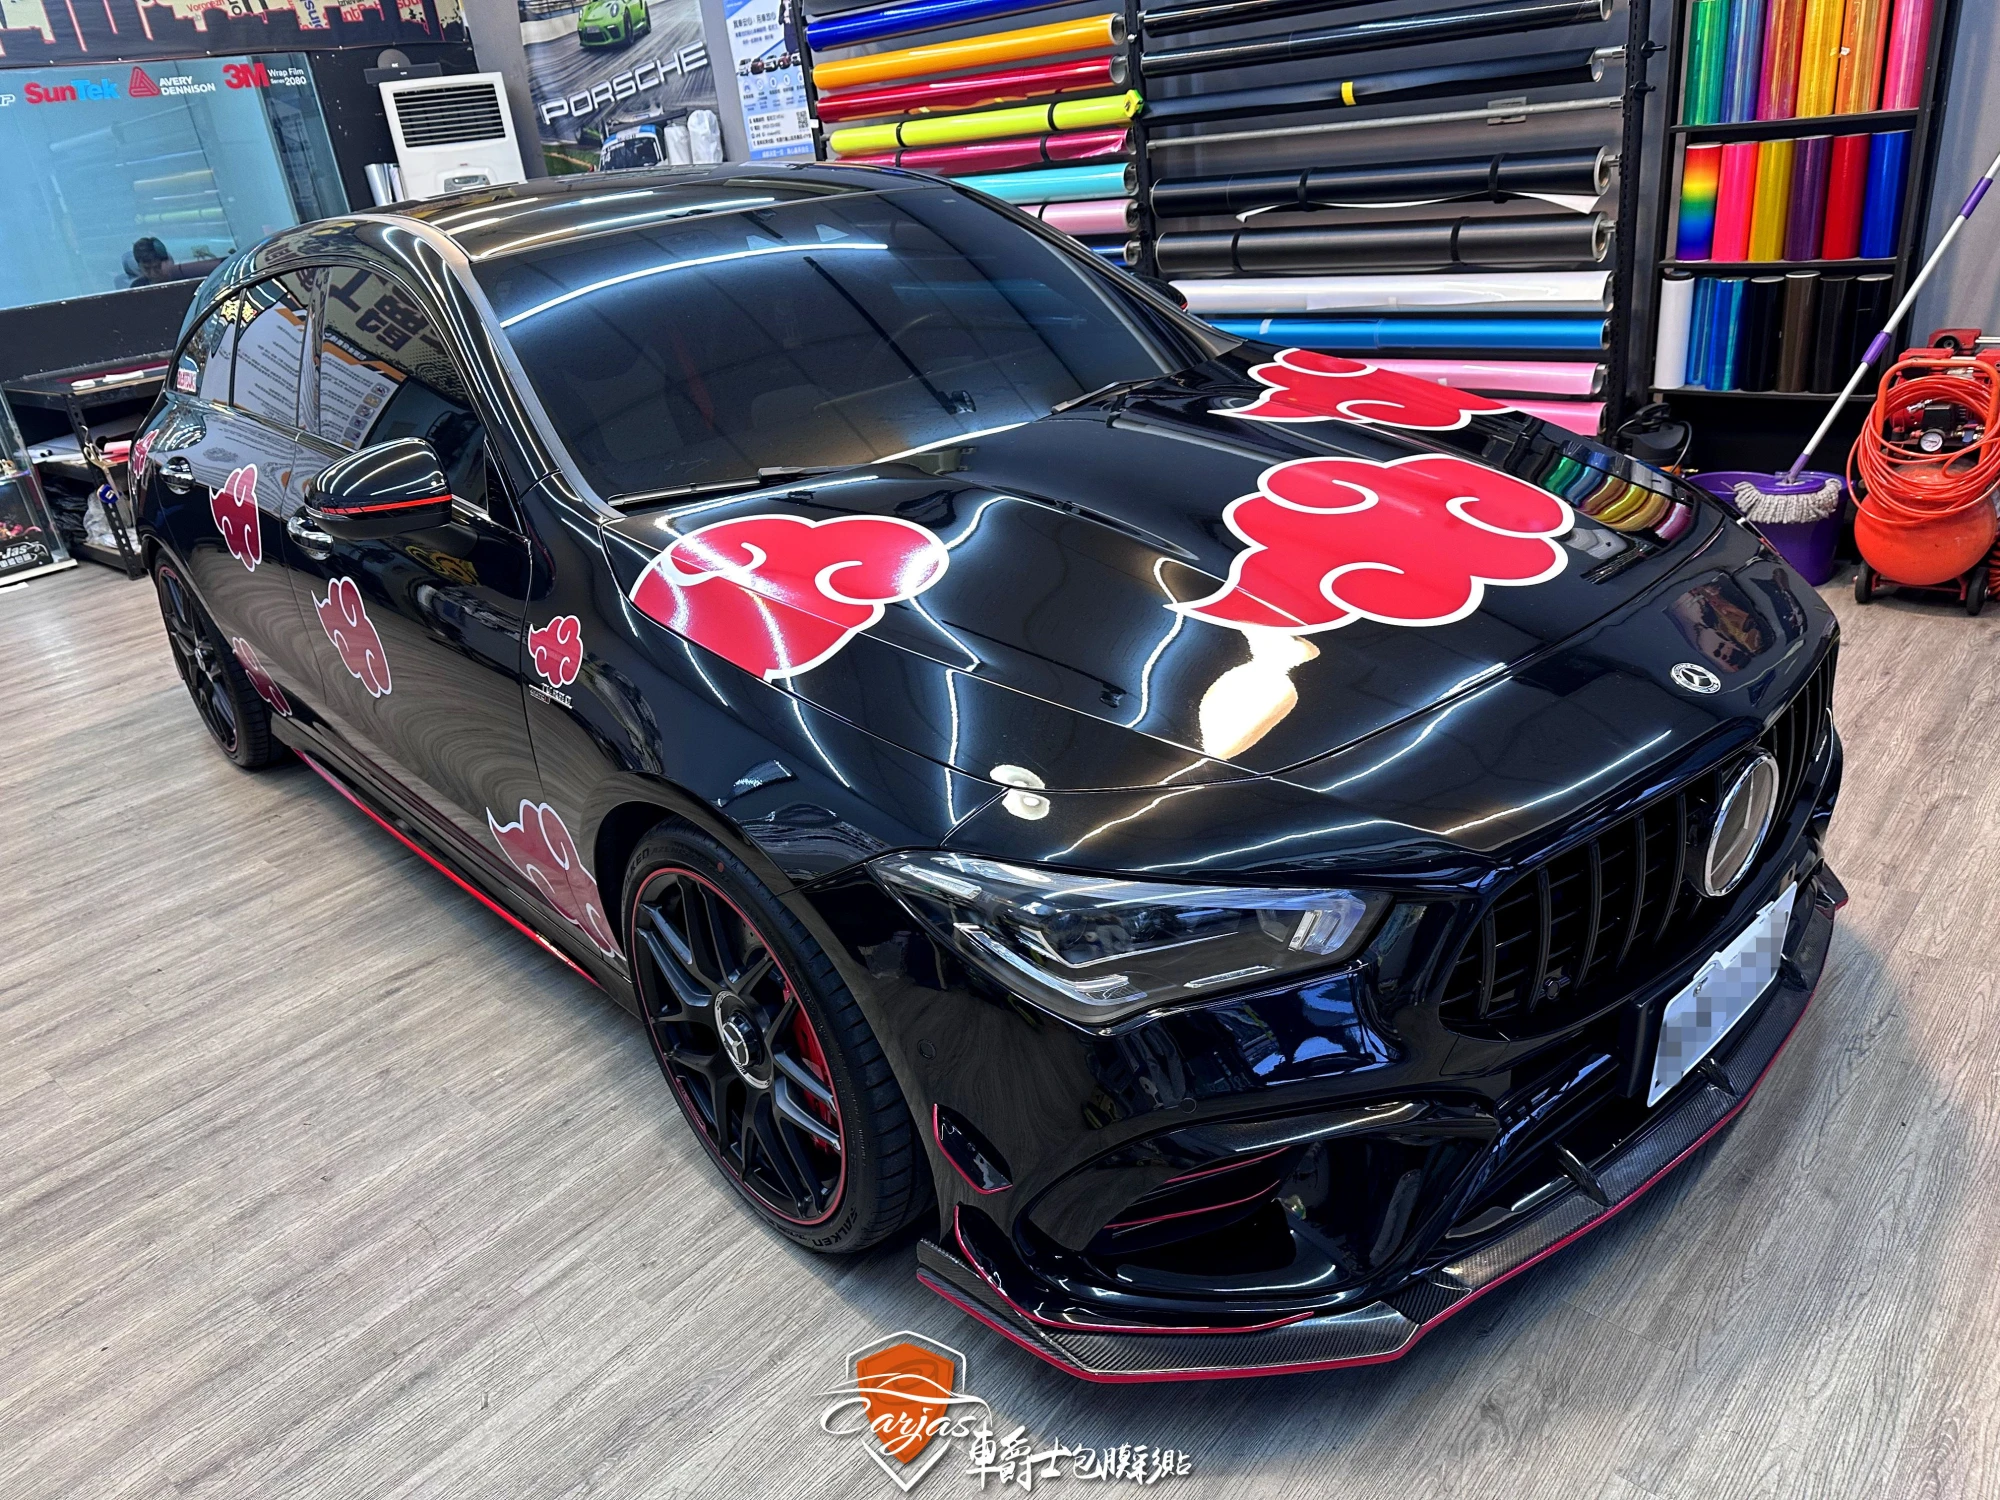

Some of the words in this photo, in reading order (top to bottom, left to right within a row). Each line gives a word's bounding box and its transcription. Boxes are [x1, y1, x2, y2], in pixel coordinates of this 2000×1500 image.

[222, 62, 270, 89] 3M
[267, 68, 288, 78] Wrap
[288, 67, 304, 76] Film
[160, 75, 192, 87] AVERY
[284, 76, 307, 86] 2080
[539, 39, 708, 125] PORSCHE
[24, 78, 120, 104] SunTek
[160, 83, 216, 96] DENNISON
